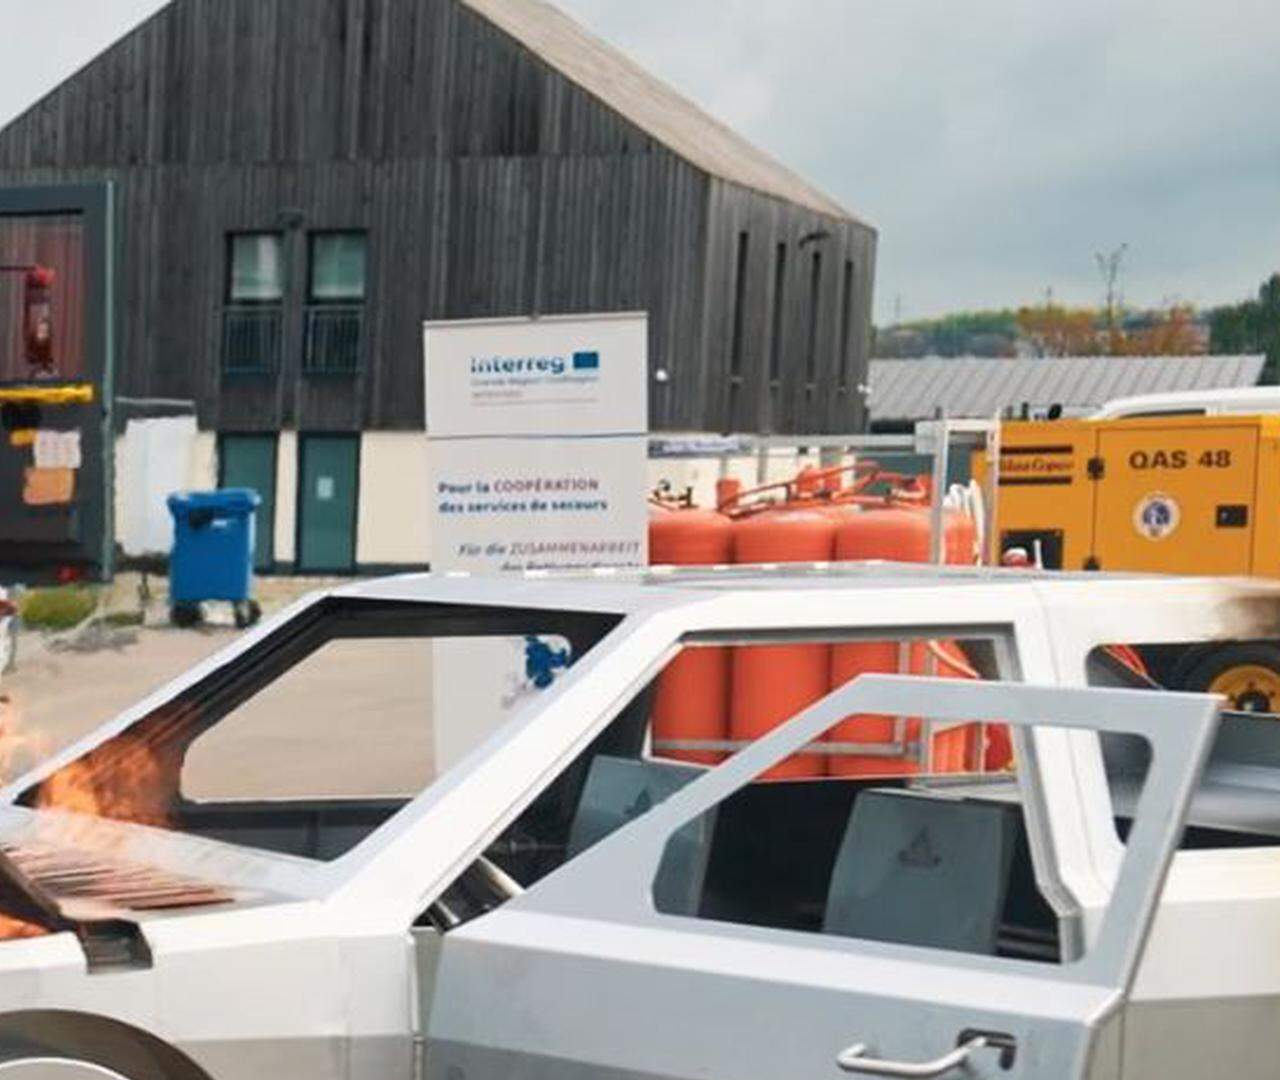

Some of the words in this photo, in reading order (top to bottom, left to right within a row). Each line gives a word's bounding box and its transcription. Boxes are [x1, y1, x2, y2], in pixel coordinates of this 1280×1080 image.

[1129, 450, 1187, 470] QAS
[1199, 449, 1231, 469] 48
[438, 482, 473, 494] Pour
[476, 481, 490, 493] la
[438, 501, 463, 513] des
[468, 500, 527, 513] services
[530, 499, 547, 511] de
[552, 500, 608, 512] secours
[485, 542, 506, 555] die
[509, 541, 640, 556] ZUSAMMENARBEIT
